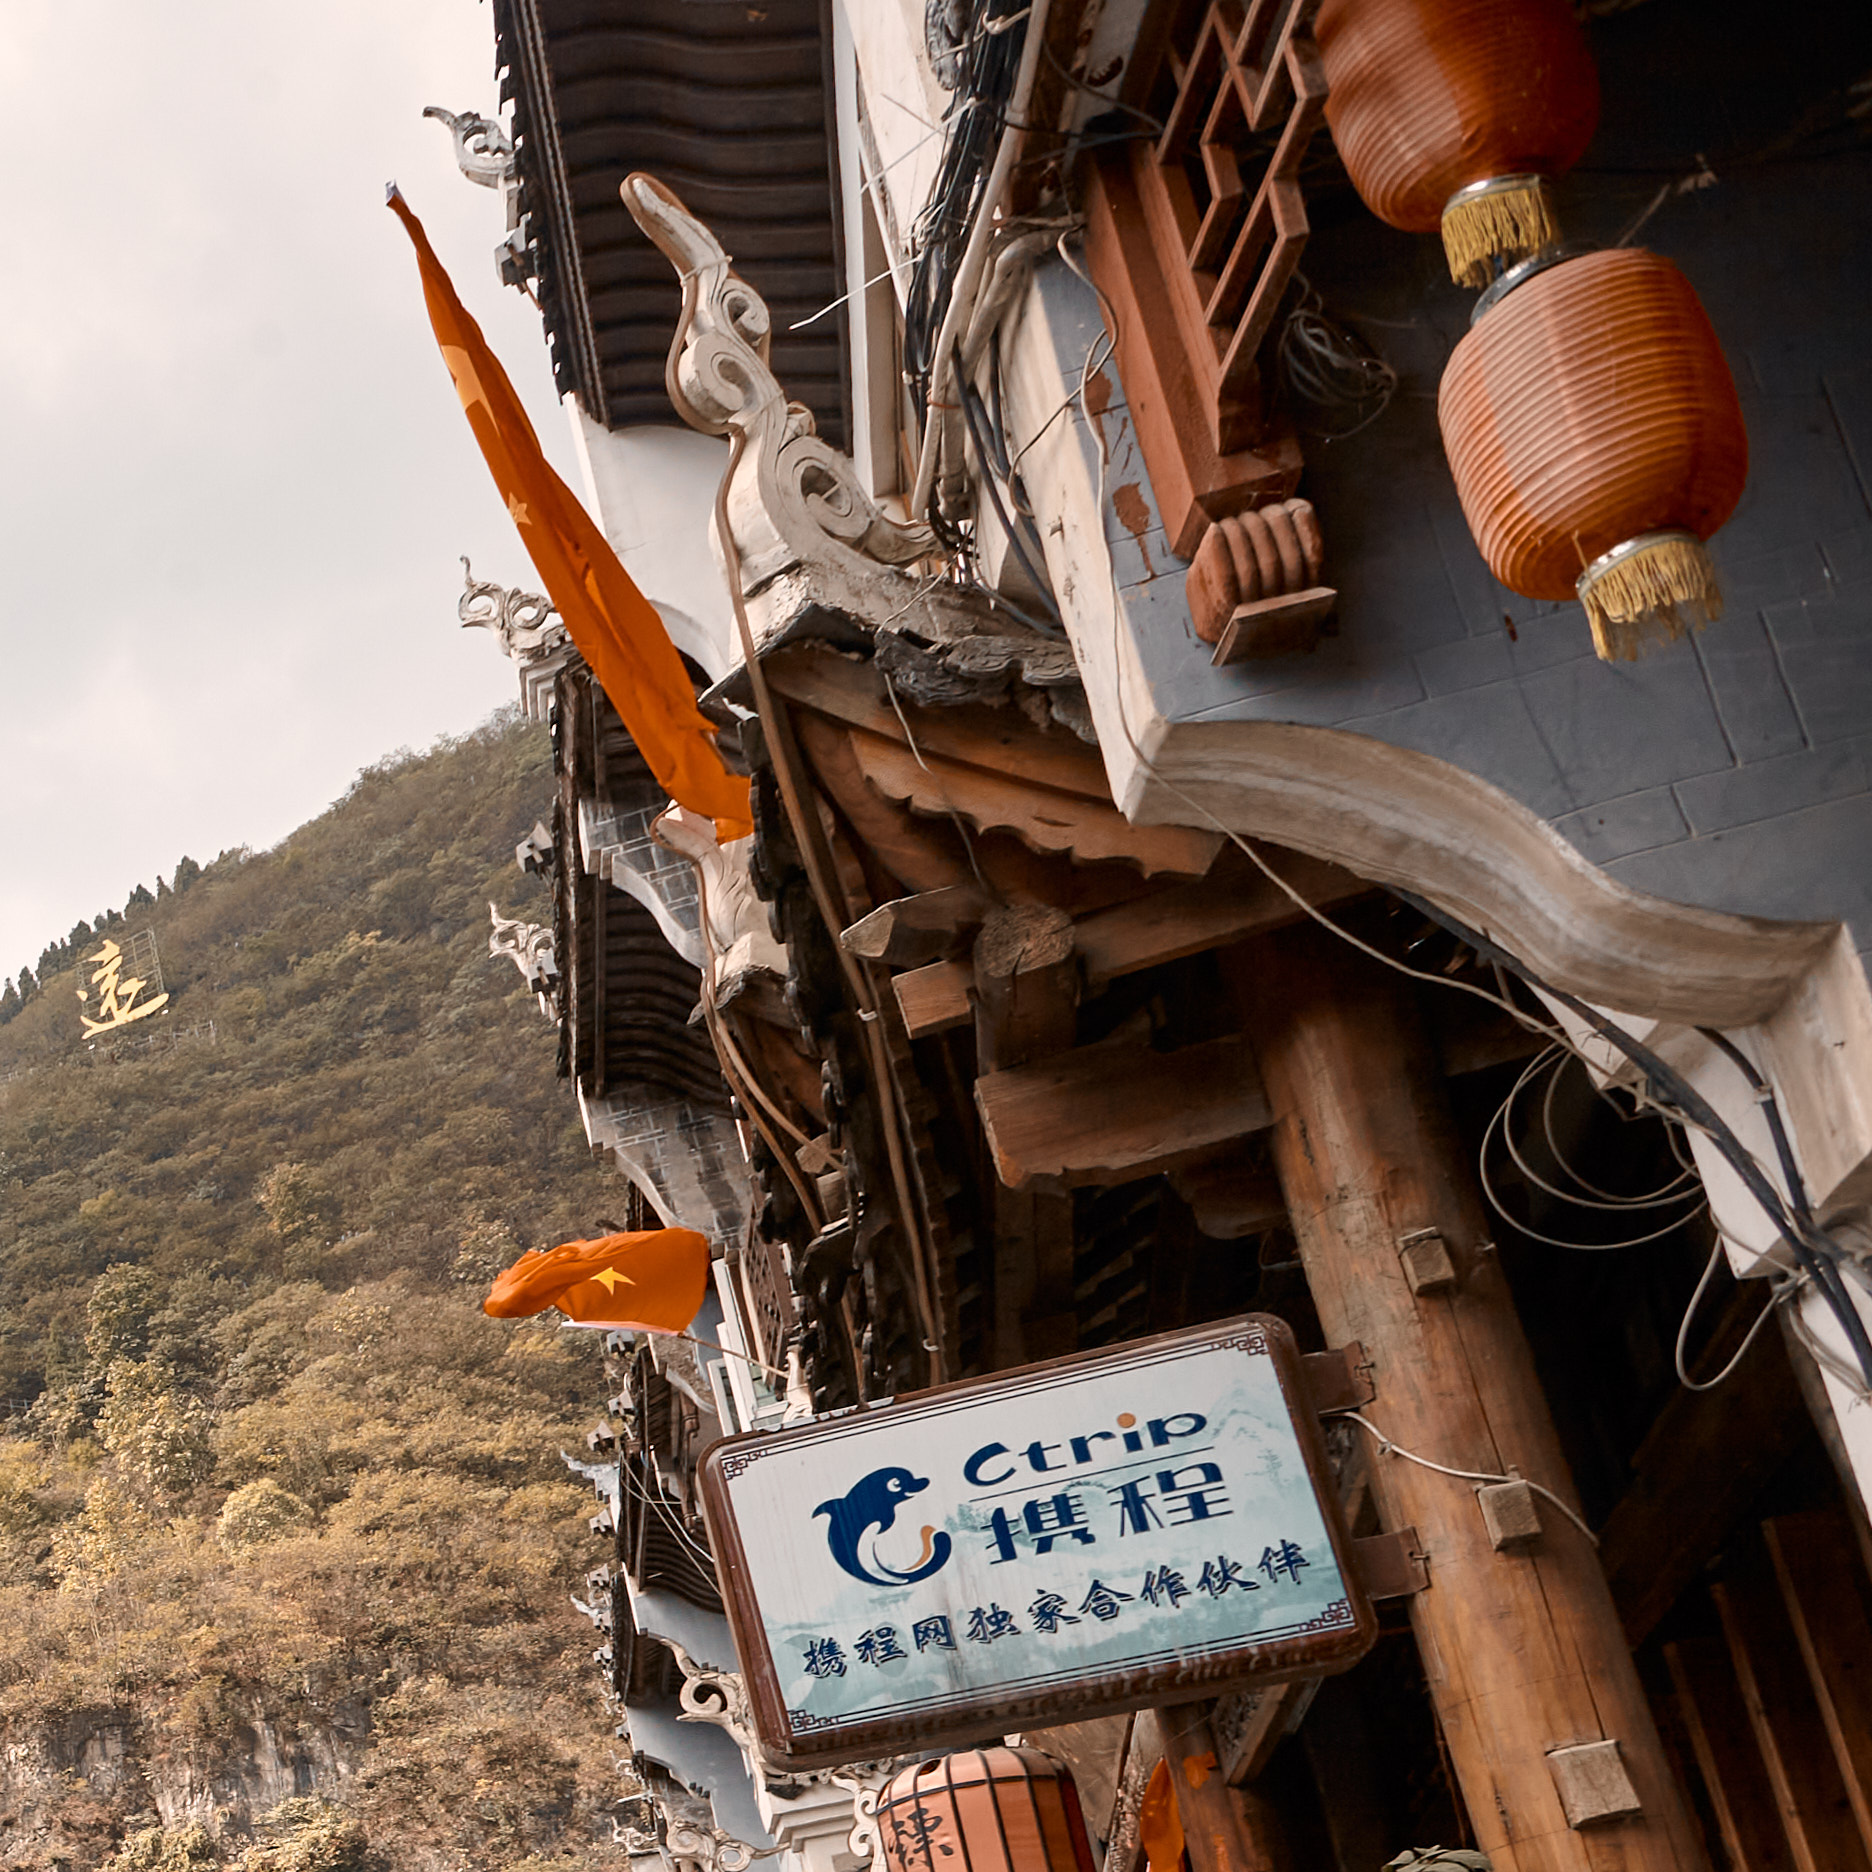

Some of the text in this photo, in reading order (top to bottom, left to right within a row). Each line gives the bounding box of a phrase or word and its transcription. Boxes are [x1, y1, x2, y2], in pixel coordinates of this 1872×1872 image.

[963, 1412, 1208, 1487] Ctrip
[981, 1462, 1235, 1565] 携程
[803, 1538, 1312, 1679] 携程网独家合作伙伴
